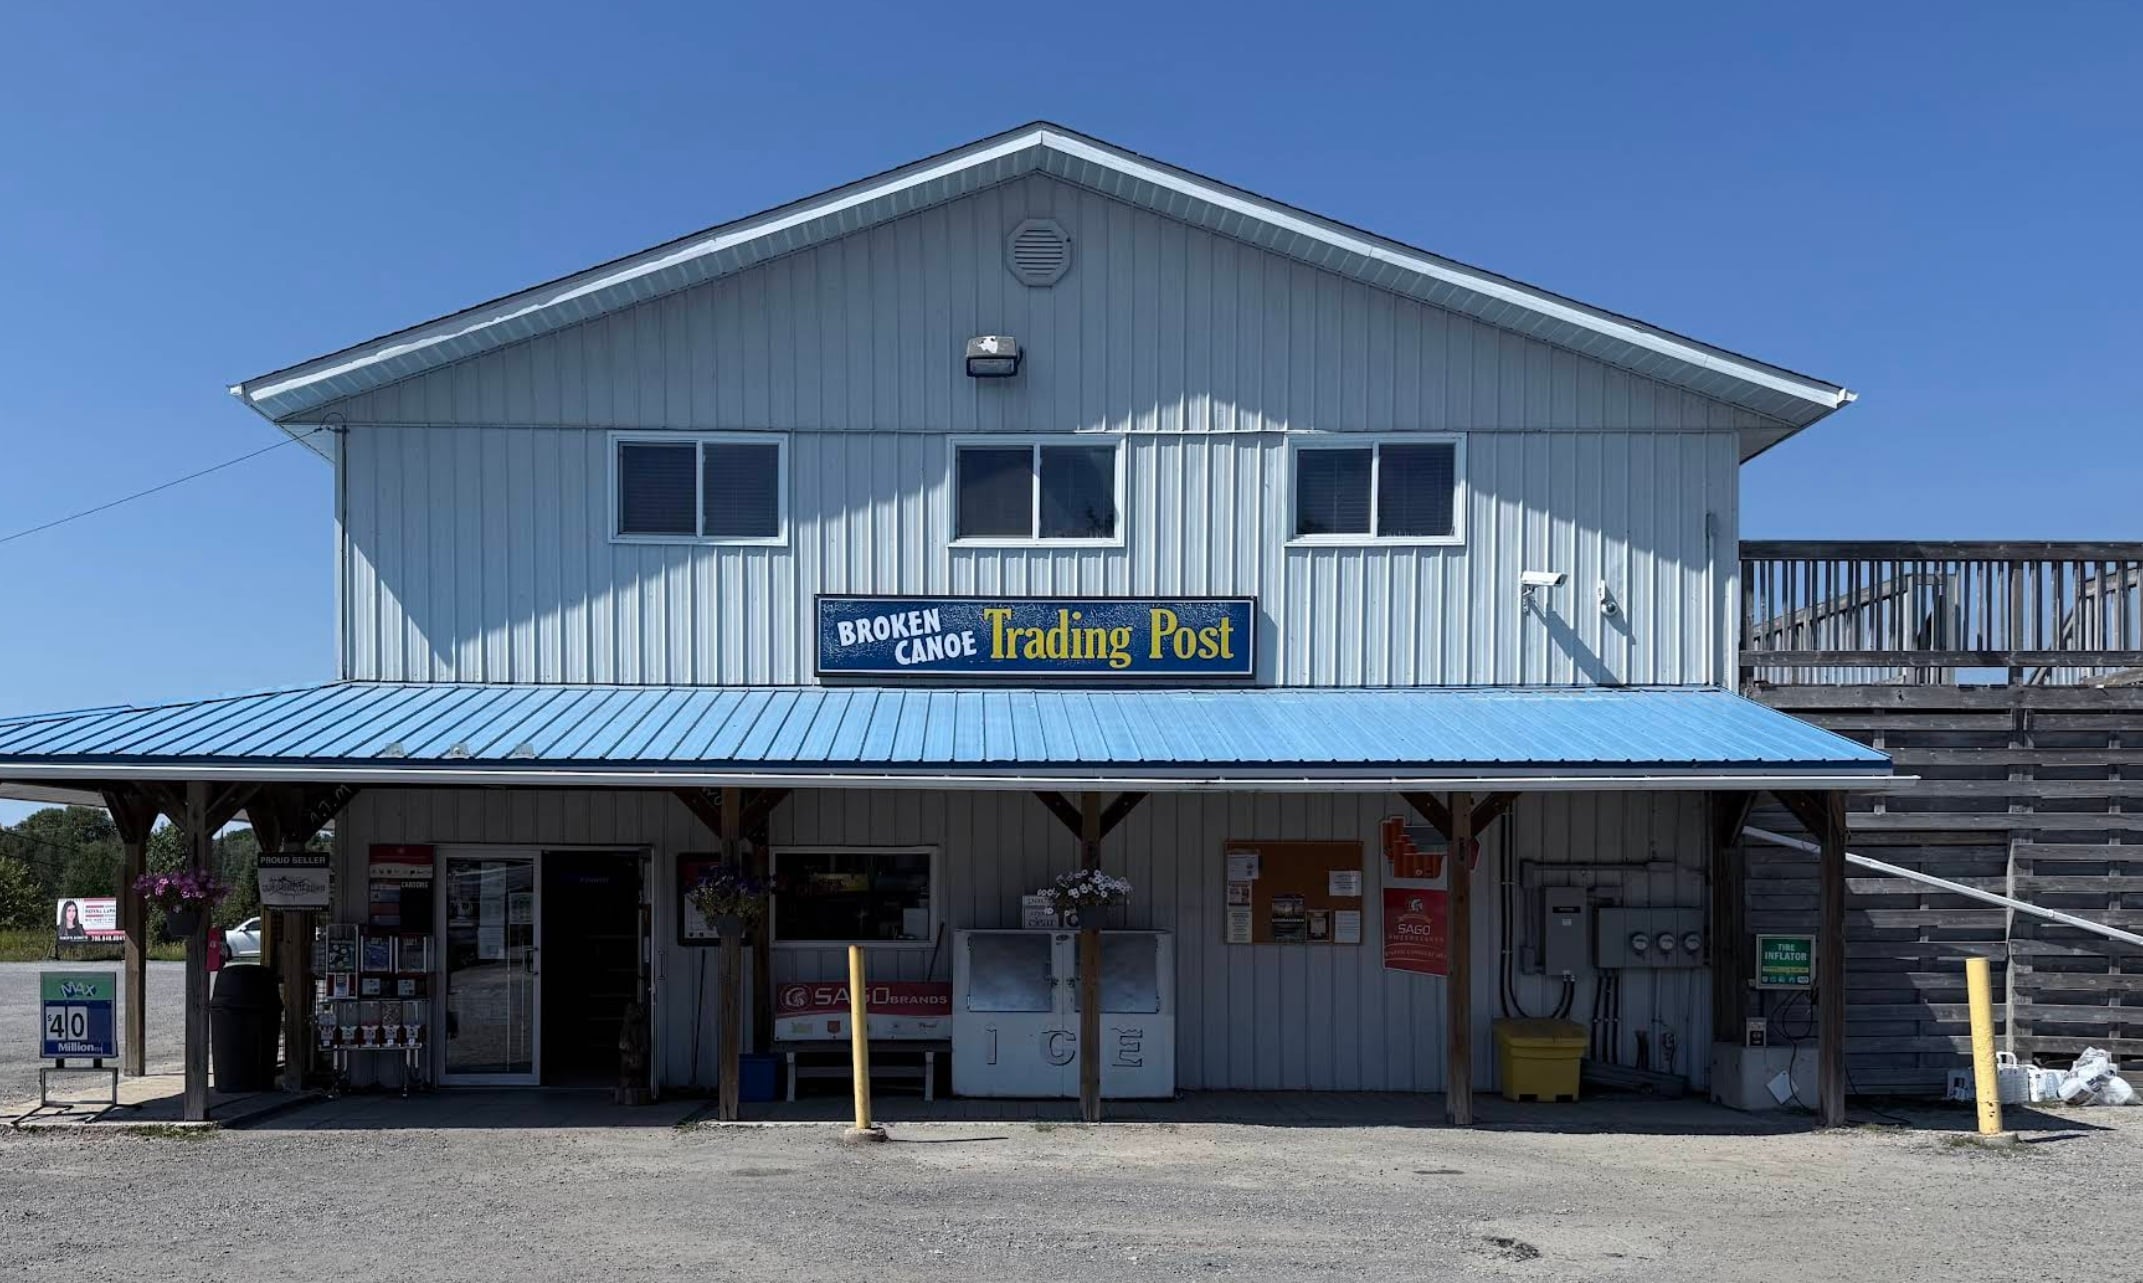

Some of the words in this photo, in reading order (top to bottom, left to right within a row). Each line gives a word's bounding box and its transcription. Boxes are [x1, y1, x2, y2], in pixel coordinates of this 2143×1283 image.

[837, 608, 941, 648] BROKEN
[983, 607, 1134, 669] Trading
[1149, 607, 1235, 660] Post
[894, 630, 978, 665] CANOE
[260, 856, 290, 865] PROUD
[291, 856, 326, 865] SELLER
[1398, 923, 1431, 935] SAGO
[1777, 943, 1796, 951] TIRE
[1764, 951, 1807, 961] INFLATOR
[60, 981, 97, 997] MAX
[890, 995, 948, 1005] BRANDS
[58, 1041, 94, 1054] Million
[985, 1025, 1143, 1067] ICE
